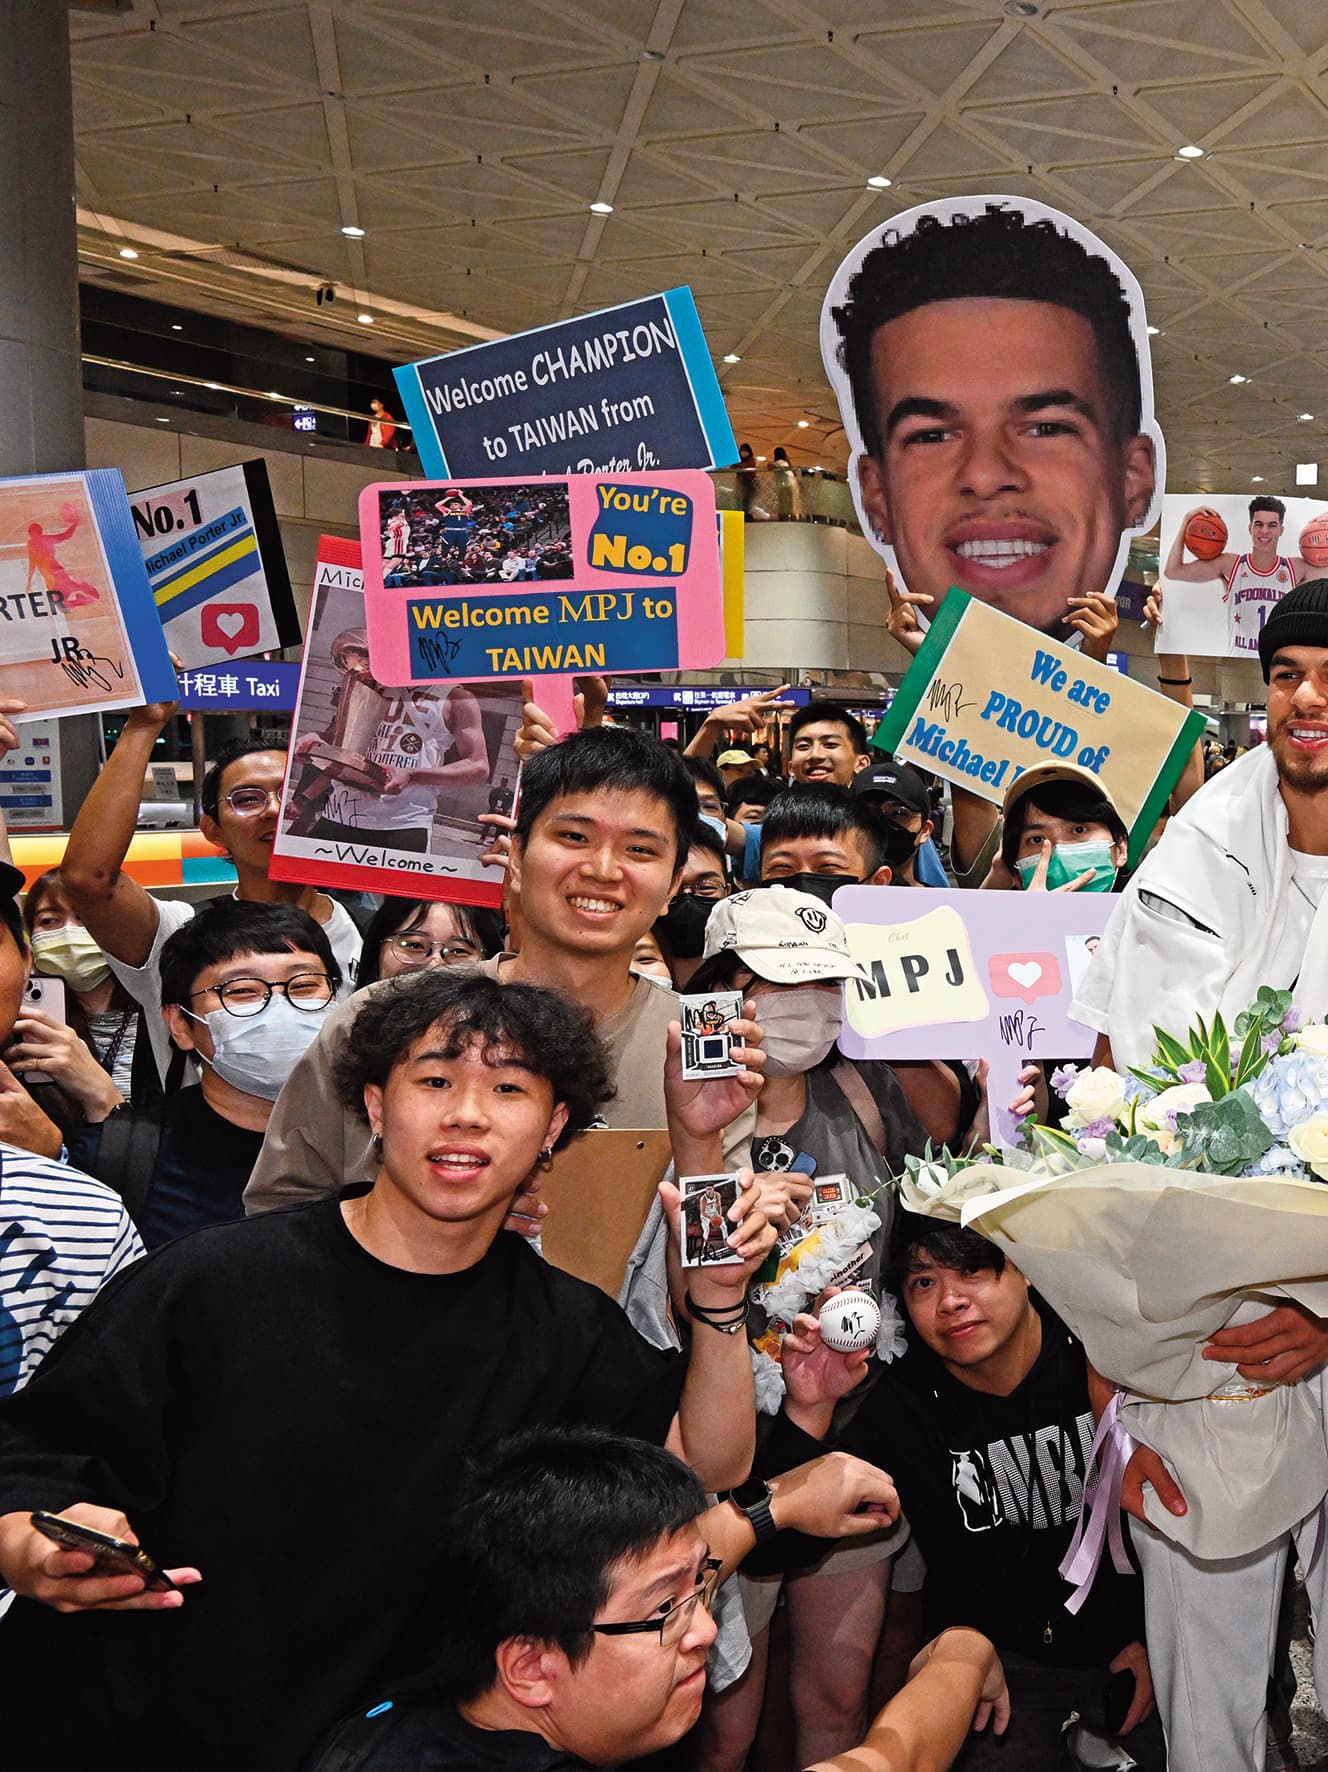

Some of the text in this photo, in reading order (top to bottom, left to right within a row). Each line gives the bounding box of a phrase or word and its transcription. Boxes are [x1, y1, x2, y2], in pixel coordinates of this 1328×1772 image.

[425, 318, 676, 415] Welcome CHAMPION
[483, 394, 655, 461] to TAIWAN from
[132, 489, 202, 540] No.1
[189, 521, 226, 550] Porter
[230, 512, 247, 527] Jr.
[591, 533, 685, 573] No.1
[412, 593, 673, 630] Welcome MPJ to
[486, 643, 606, 671] TAIWAN
[1031, 650, 1111, 714] We are
[246, 676, 280, 697] Taxi
[907, 717, 1010, 788] Michael
[980, 690, 1110, 774] PROUD of
